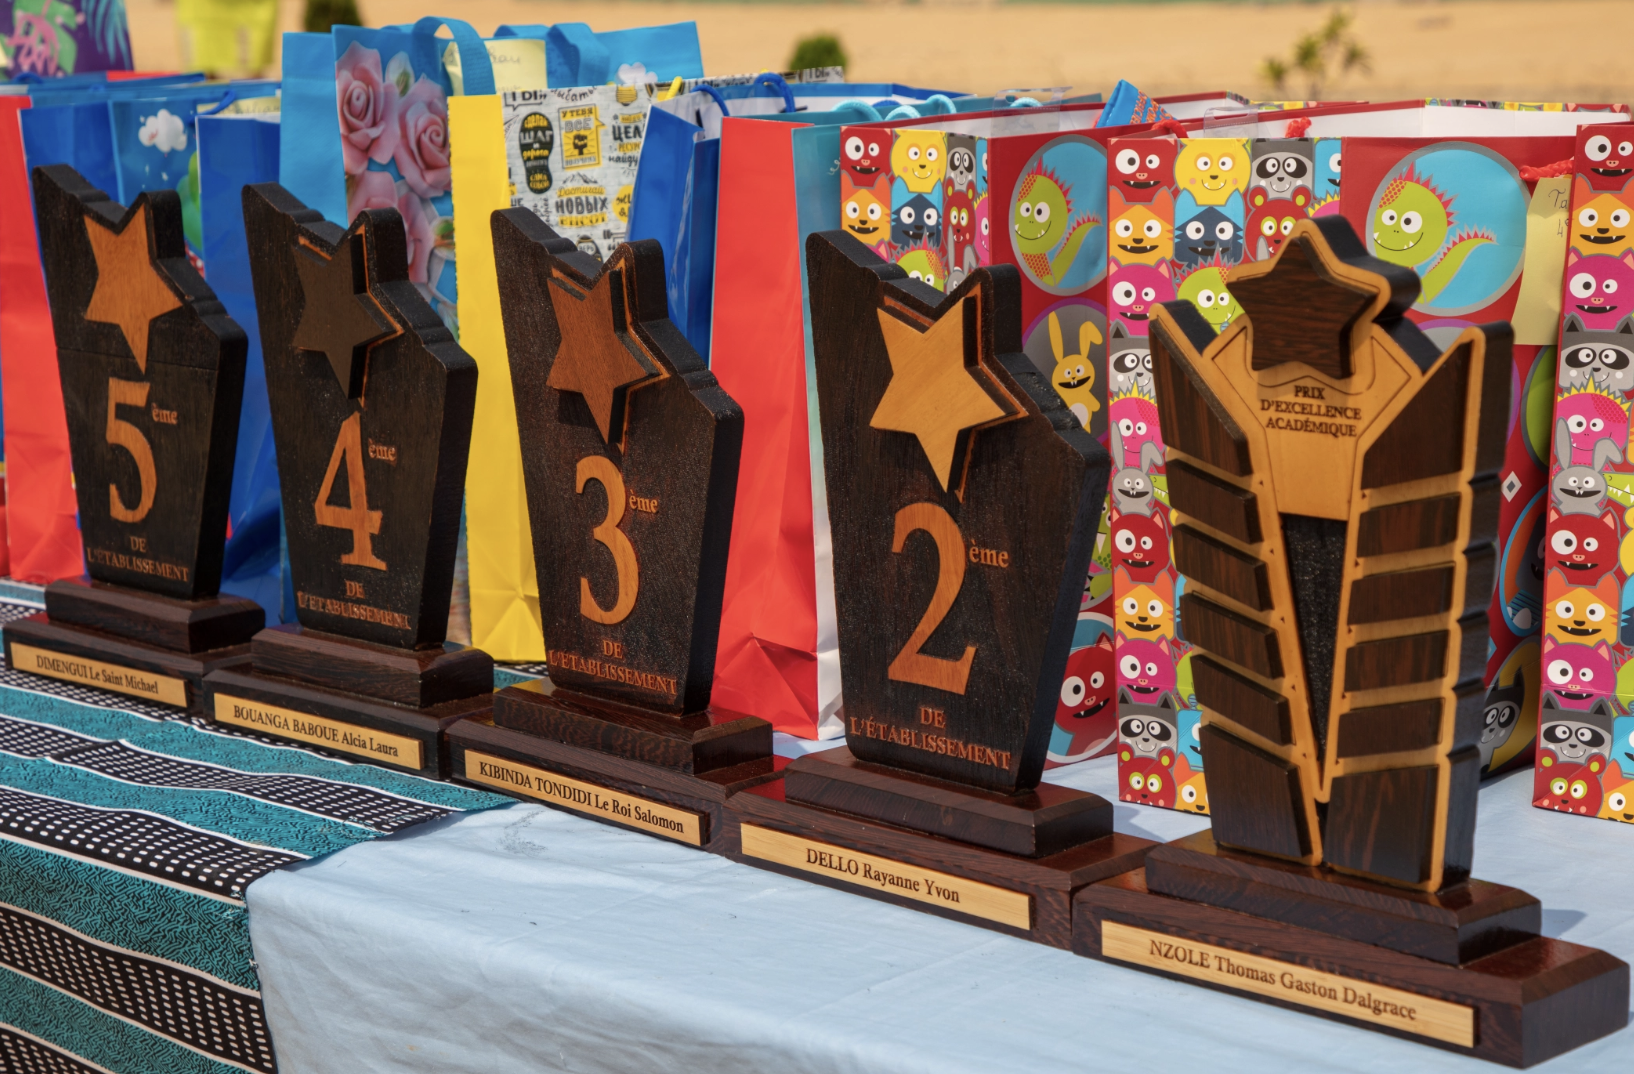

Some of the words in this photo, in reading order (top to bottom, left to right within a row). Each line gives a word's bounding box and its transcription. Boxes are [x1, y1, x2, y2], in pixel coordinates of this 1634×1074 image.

[569, 107, 593, 118] ТЕБЯ
[520, 130, 553, 145] ШАГ
[608, 152, 638, 168] найду
[555, 195, 608, 215] НОВЫХ
[1294, 385, 1325, 400] PRIX
[1260, 399, 1362, 420] D'EXCELLENCE
[1265, 416, 1356, 438] ACADÉMIQUE
[129, 536, 147, 553] DE
[345, 579, 366, 599] DE
[602, 640, 623, 660] DE
[36, 655, 88, 679] DIMENGUI
[89, 666, 101, 681] Le
[102, 669, 123, 687] Saint
[124, 674, 159, 695] Michael
[920, 707, 946, 729] DE
[233, 704, 290, 731] BOUANGA
[292, 718, 339, 743] BABOUE
[341, 731, 367, 750] Alcia
[369, 737, 399, 757] Laura
[850, 716, 1011, 770] L'ÉTABLISSEMENT
[479, 761, 532, 789] KIBINDA
[535, 776, 592, 807] TONDIDI
[594, 794, 609, 811] Le
[612, 798, 632, 818] Roi
[634, 806, 684, 834] Salomon
[806, 847, 859, 876] DELLO
[862, 862, 920, 892] Rayanne
[923, 878, 960, 903] Yvon
[1149, 939, 1210, 968] NZOLE
[1214, 954, 1276, 986] Thomas
[1280, 971, 1338, 1001] Gaston
[1342, 987, 1417, 1021] Dalgrace
